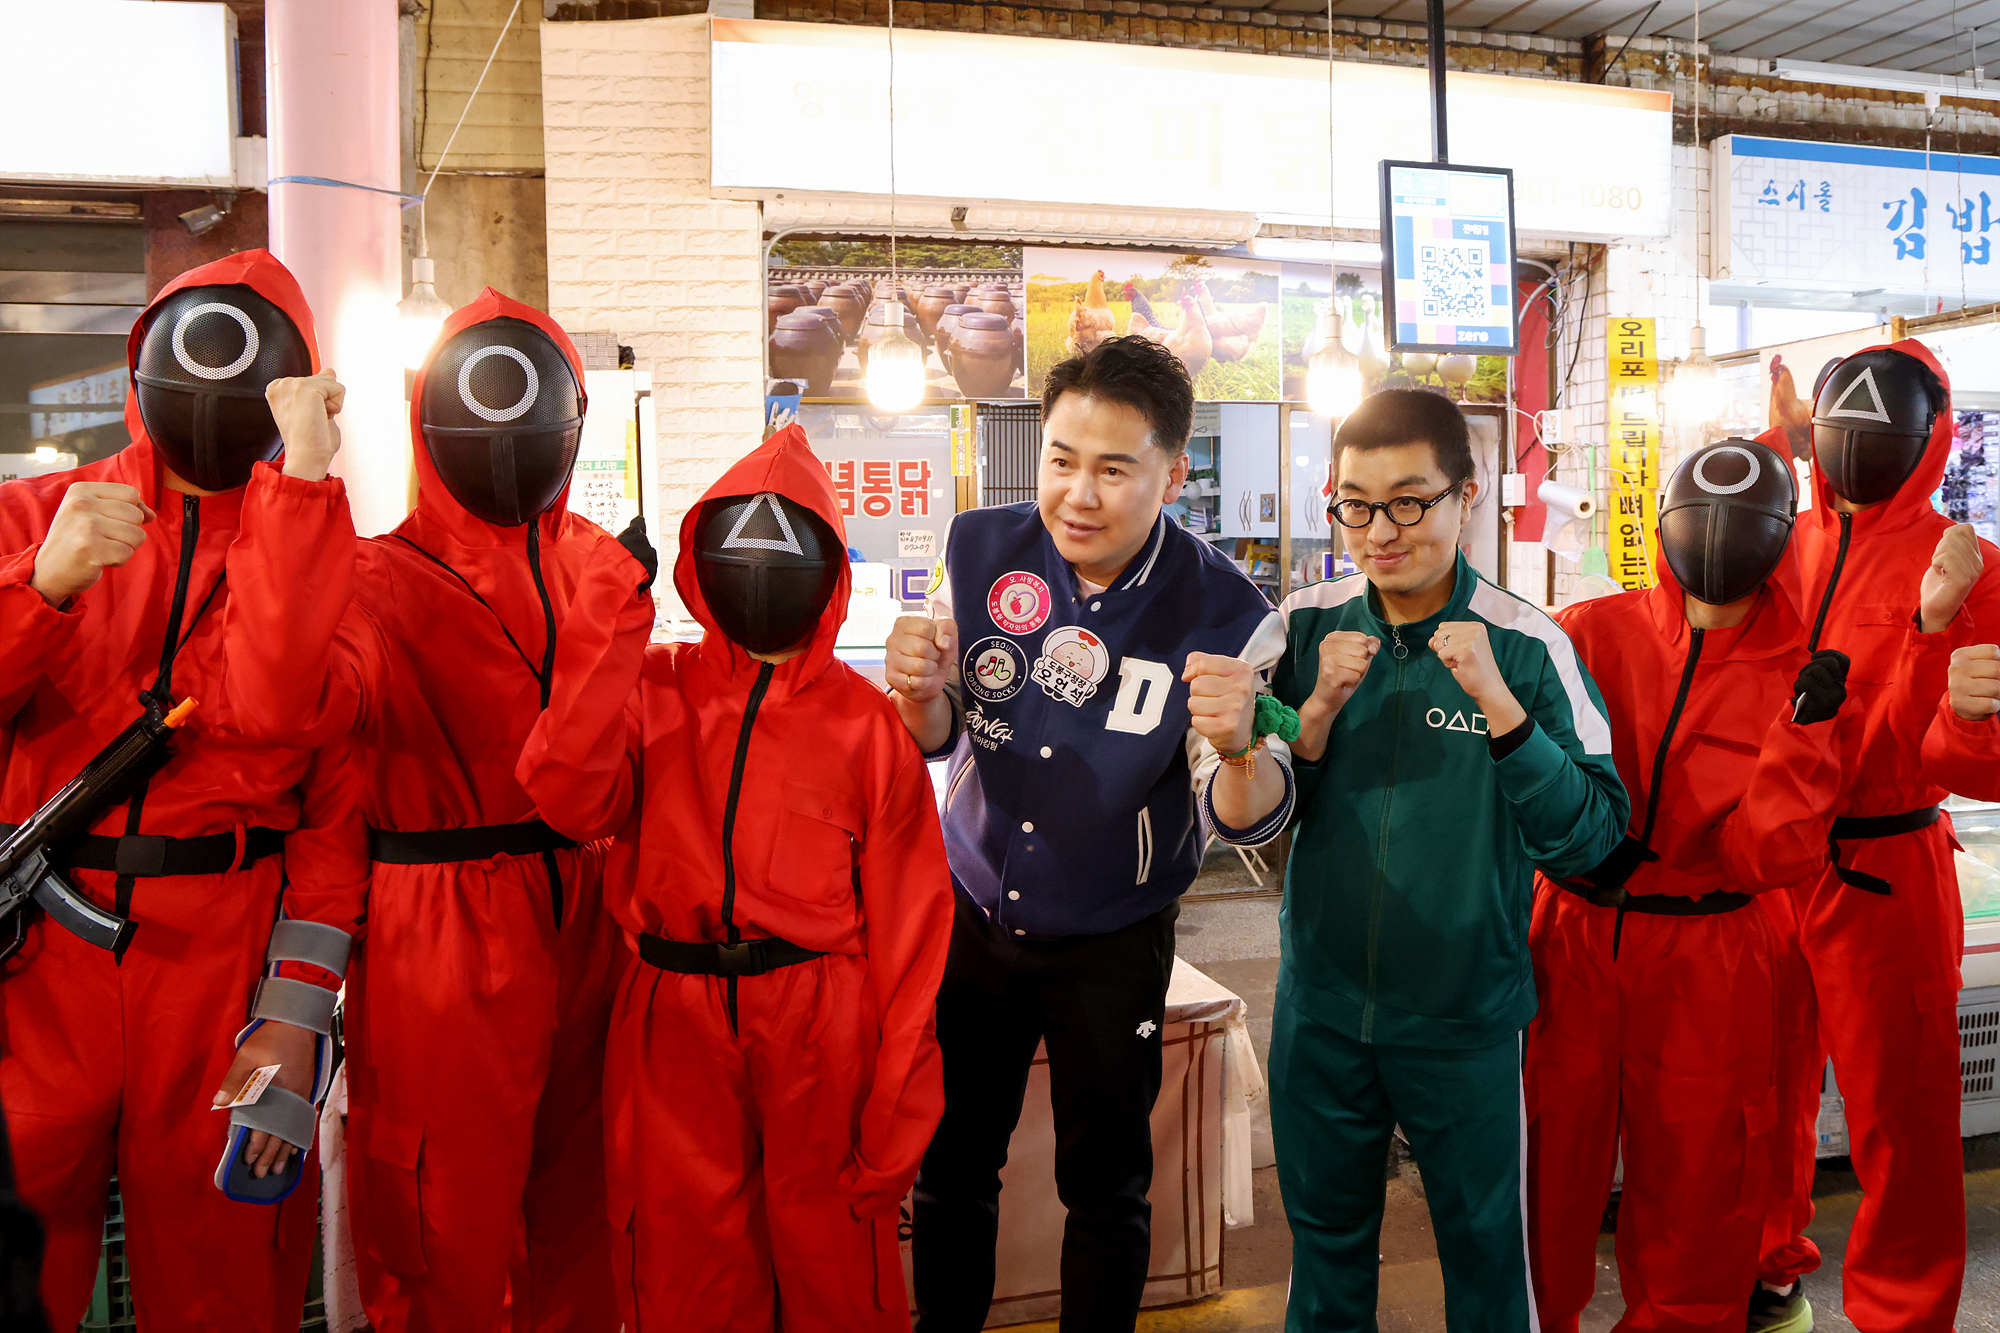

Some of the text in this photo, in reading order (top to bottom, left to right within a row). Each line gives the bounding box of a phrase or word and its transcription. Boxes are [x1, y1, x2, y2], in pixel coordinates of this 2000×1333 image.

[1758, 179, 1833, 212] 스시롤
[1882, 187, 2000, 265] 김밥
[1457, 329, 1489, 343] zero
[1618, 321, 1647, 377] 오리포
[990, 640, 1015, 655] SEOUL
[966, 671, 1016, 699] DOBONG SOCKS
[1048, 661, 1087, 688] 도봉구청장
[1105, 656, 1174, 736] D
